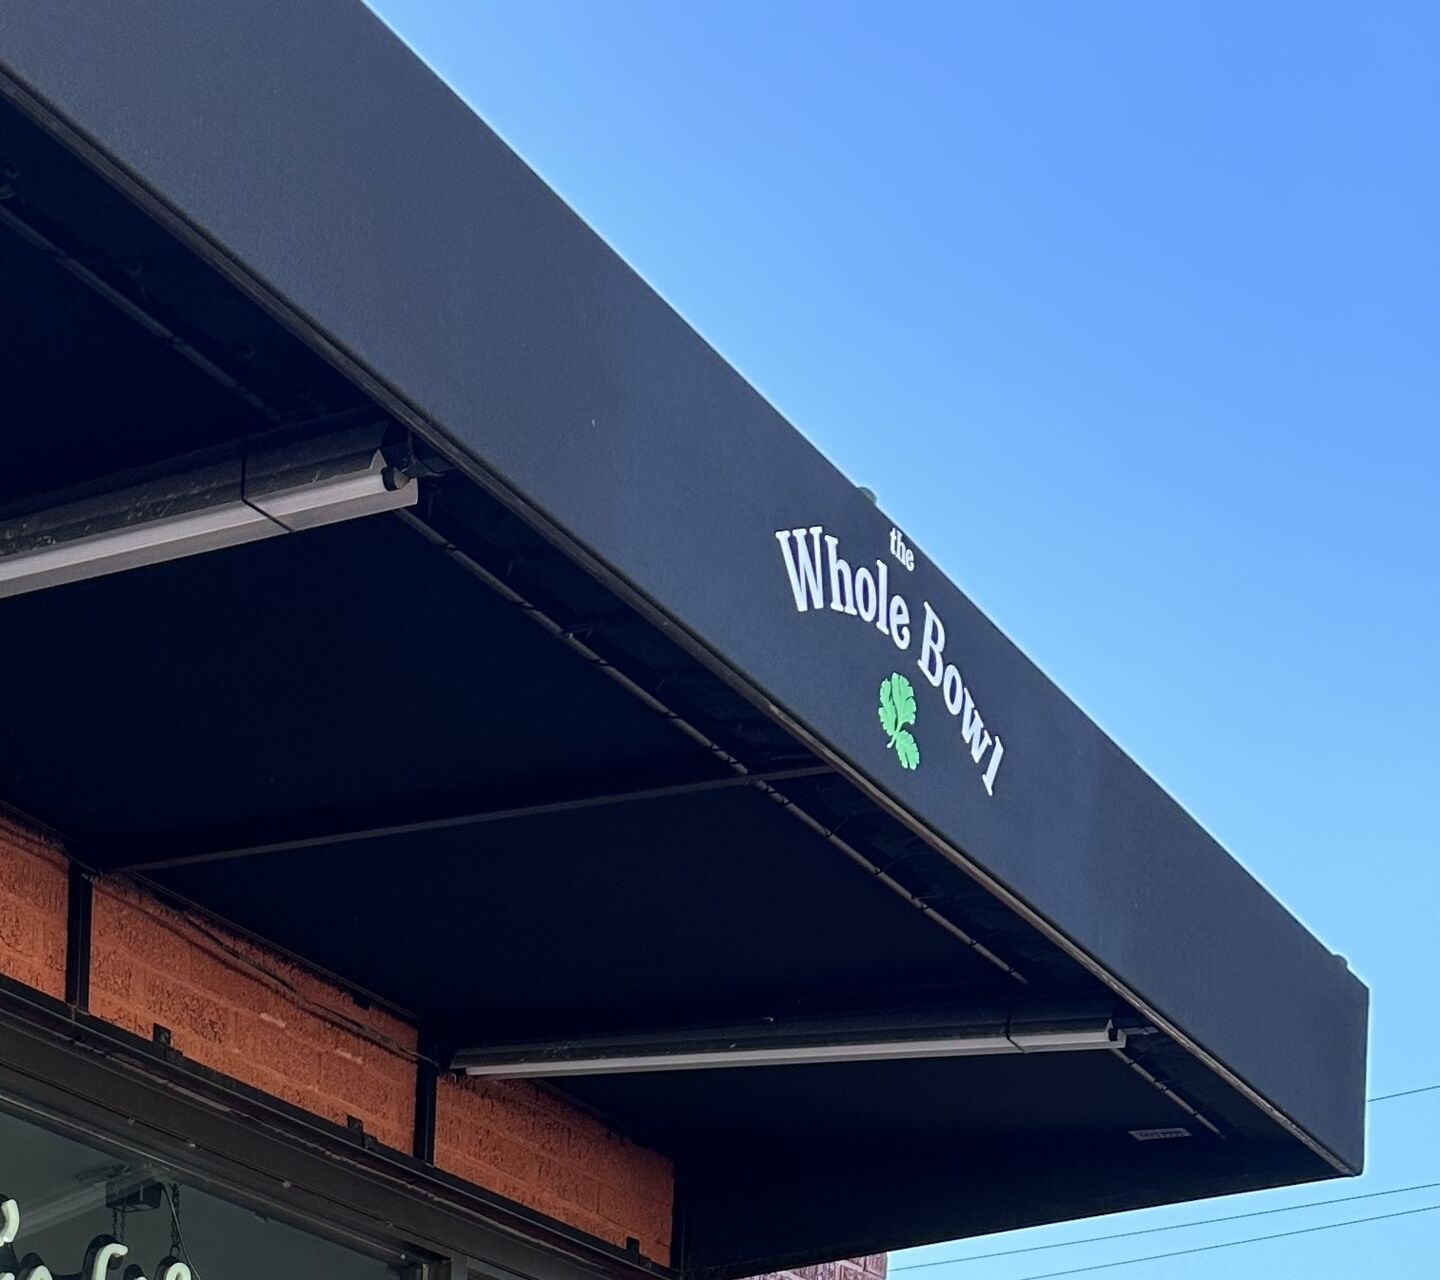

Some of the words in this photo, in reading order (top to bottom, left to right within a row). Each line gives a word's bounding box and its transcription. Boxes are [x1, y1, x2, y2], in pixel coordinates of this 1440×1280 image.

[890, 527, 915, 571] the
[775, 526, 910, 650] Whole
[918, 601, 1004, 796] Bowl
